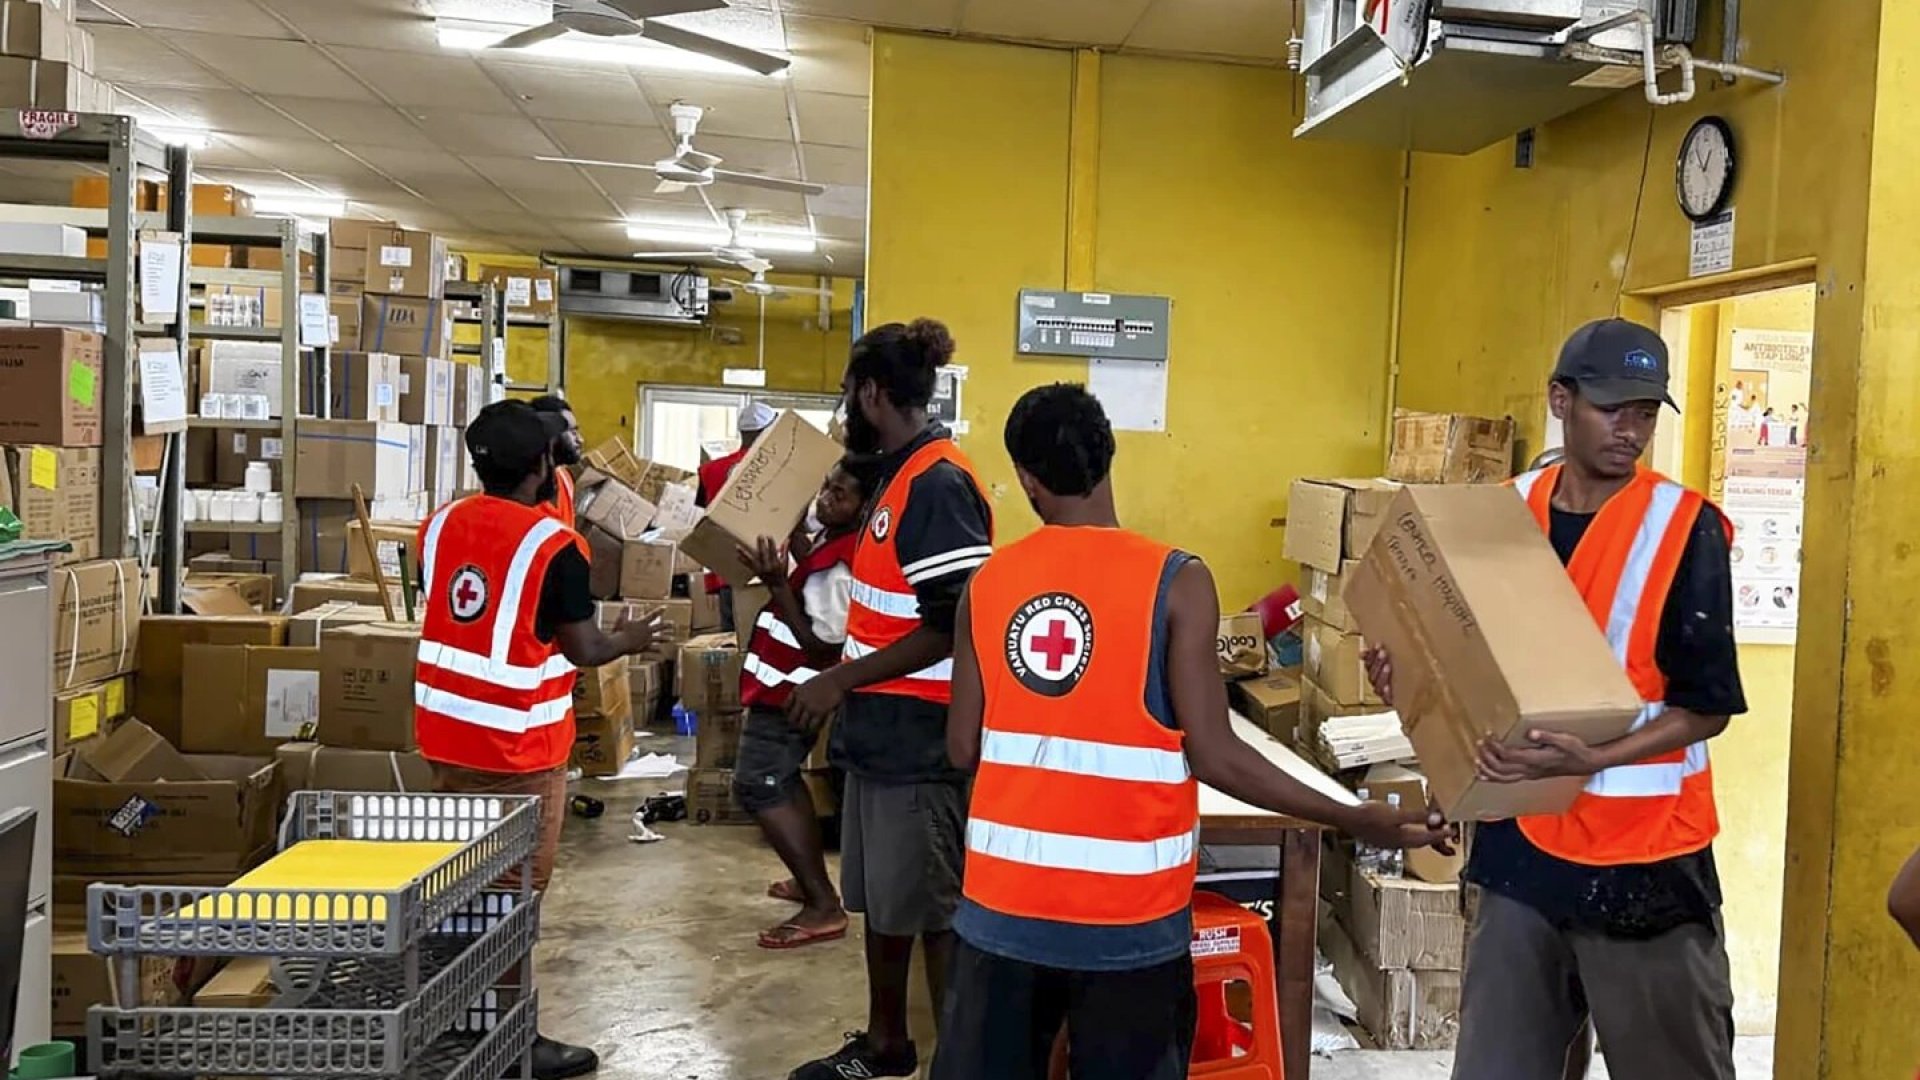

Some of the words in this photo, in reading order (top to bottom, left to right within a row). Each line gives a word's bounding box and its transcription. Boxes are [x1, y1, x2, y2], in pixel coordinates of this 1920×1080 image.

[22, 111, 76, 125] FRAGILE
[1007, 614, 1026, 678] VANUATU
[1024, 597, 1051, 615] RED
[1054, 596, 1089, 623] CROSS
[1072, 623, 1092, 681] SOCIETY
